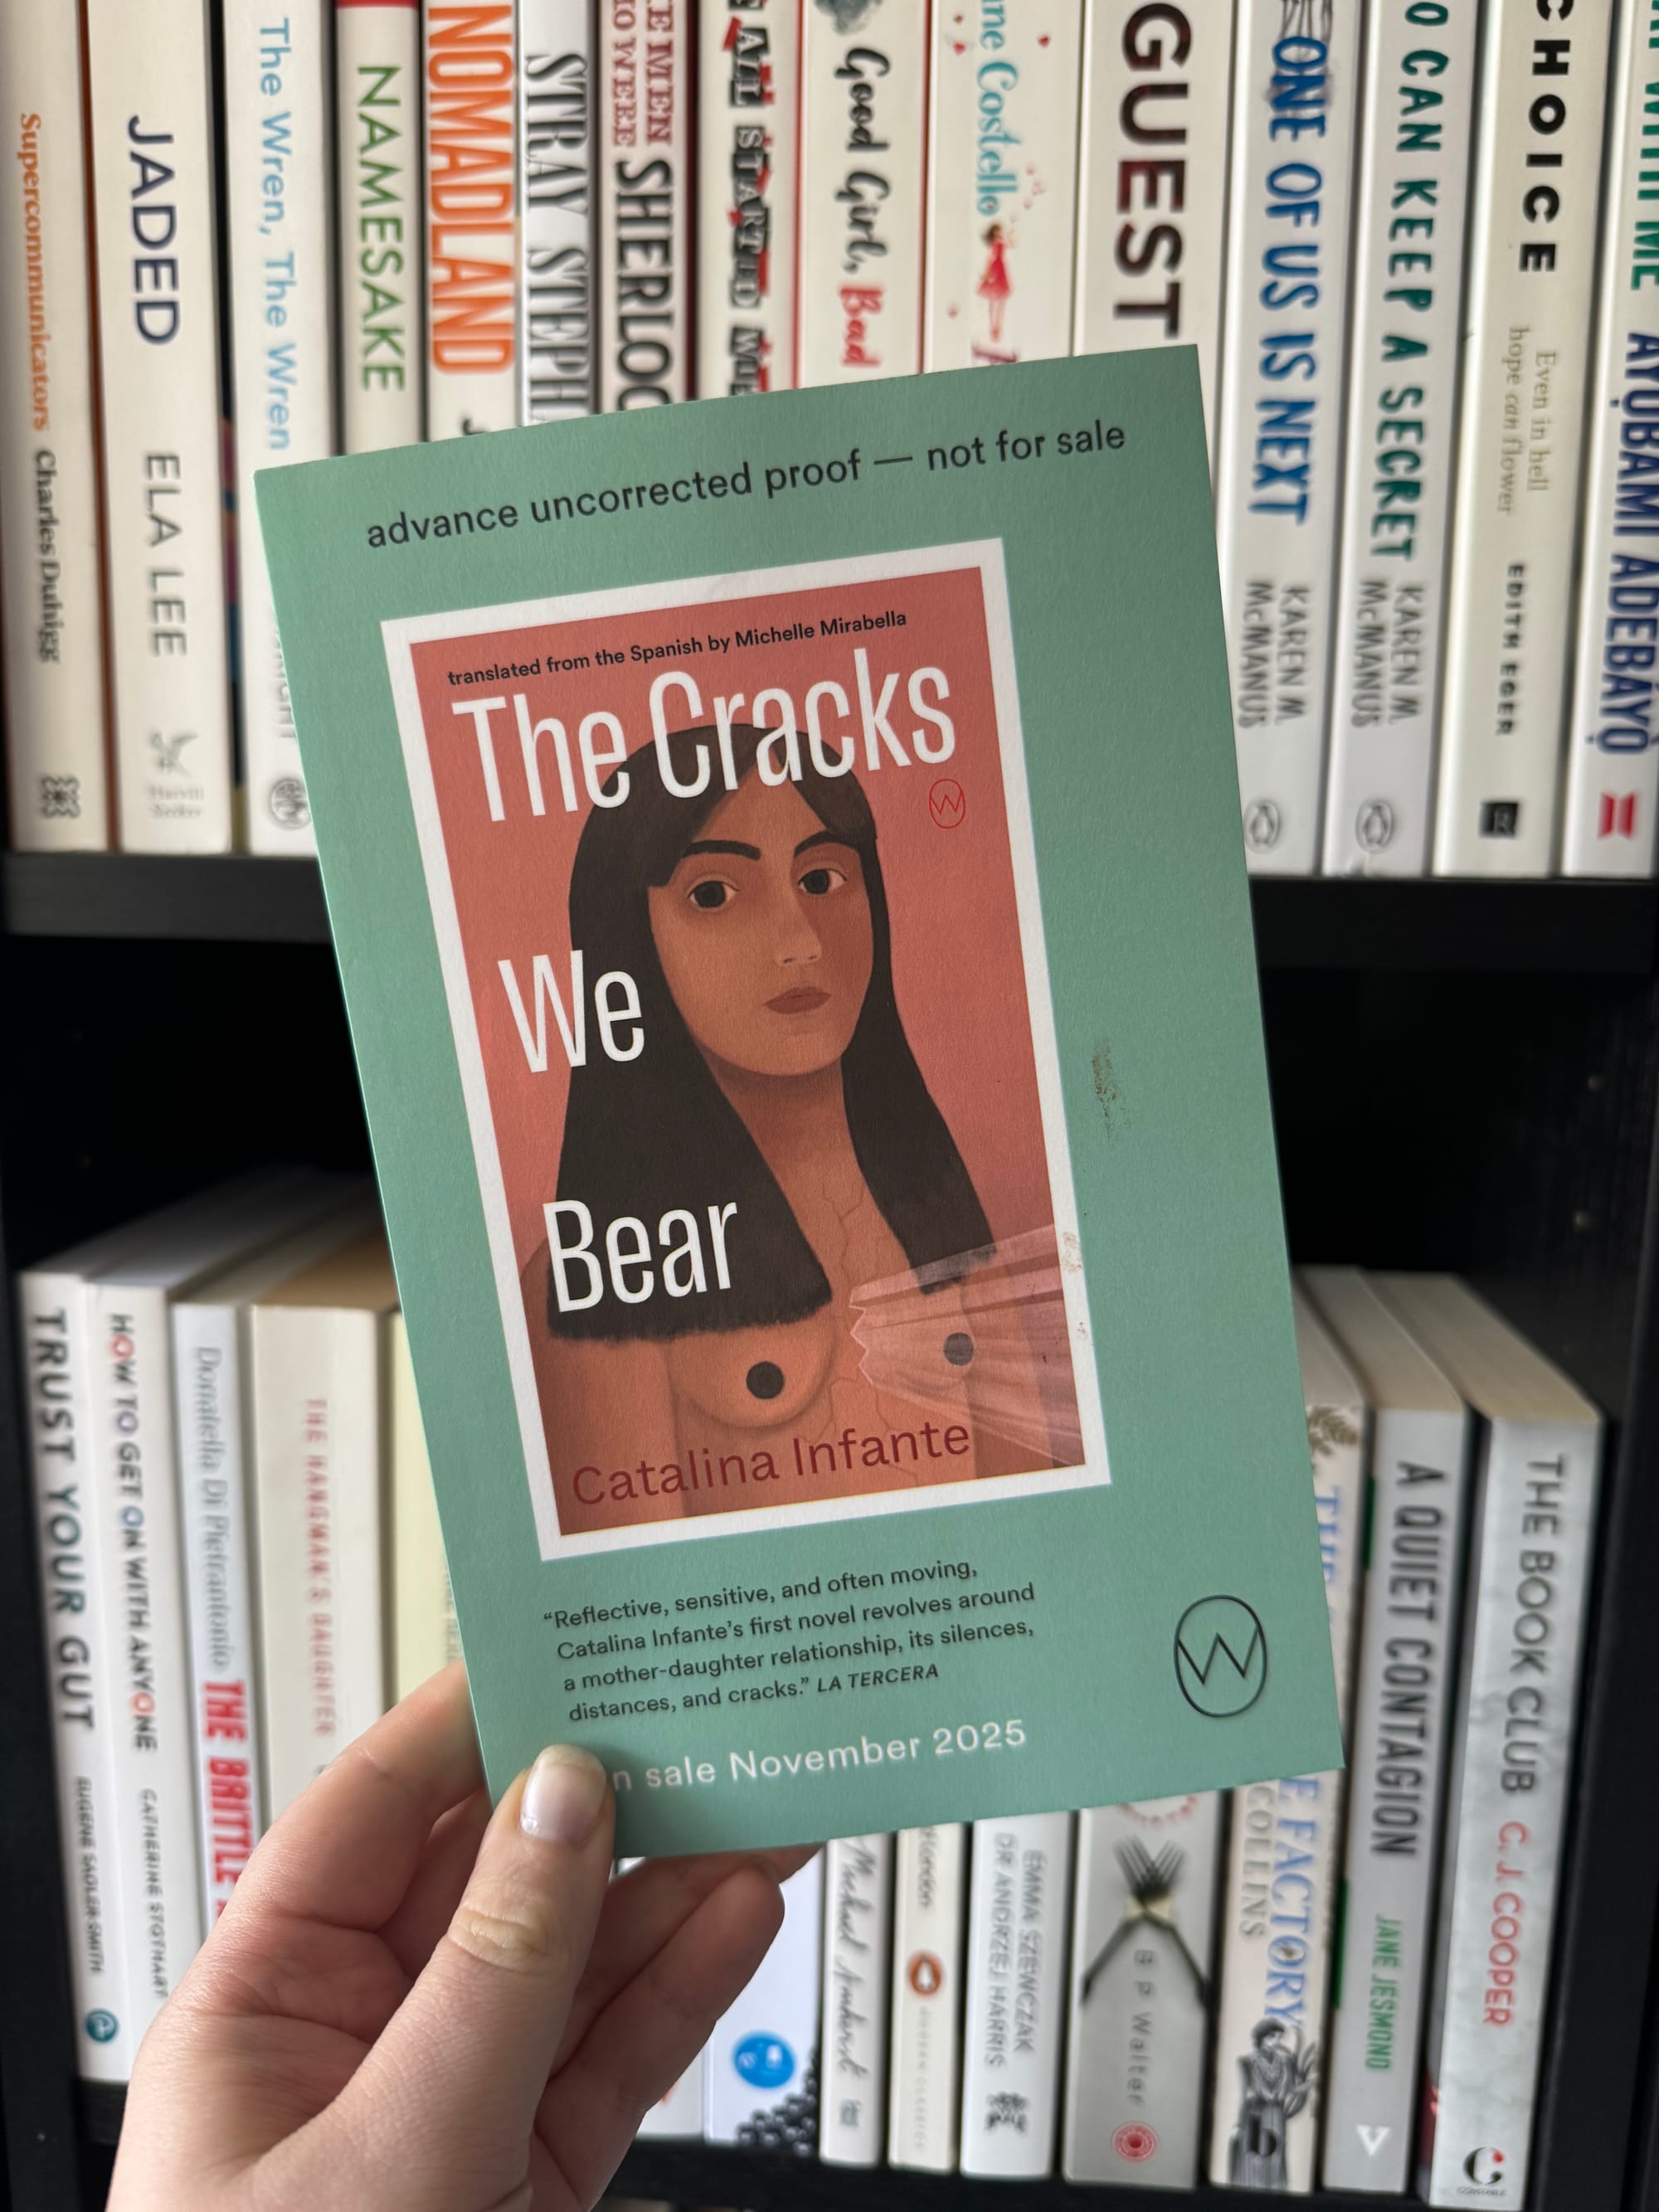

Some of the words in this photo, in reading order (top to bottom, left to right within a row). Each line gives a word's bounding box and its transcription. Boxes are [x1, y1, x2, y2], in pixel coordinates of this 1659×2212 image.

[259, 17, 291, 96] The
[733, 27, 768, 107] ALL
[980, 0, 1005, 50] ne
[525, 53, 588, 216] STRAY
[612, 36, 637, 148] WERE
[647, 41, 674, 146] MEN
[834, 47, 890, 152] Good
[1269, 36, 1327, 141] ONE
[1397, 49, 1449, 153] CAN
[1519, 0, 1574, 272] CHOICE
[259, 111, 292, 236] Wren,
[977, 61, 1020, 216] Costello
[1113, 2, 1192, 339] GUEST
[129, 115, 180, 345] JADED
[358, 66, 404, 391] NAMESAKE
[429, 5, 514, 374] NOMADLAND
[733, 125, 768, 308] STARTED
[835, 171, 890, 274] Girl,
[1266, 163, 1321, 228] OF
[17, 113, 51, 432] Supercommunicators
[265, 252, 297, 328] The
[1259, 245, 1320, 310] US
[1383, 179, 1437, 312] KEEP
[527, 248, 589, 423] STEPH
[839, 284, 883, 367] Bad
[1258, 333, 1316, 382] IS
[1381, 334, 1428, 362] A
[1501, 326, 1530, 386] hope
[266, 343, 298, 450] Wren
[1505, 394, 1521, 434] can
[1531, 415, 1551, 439] in
[1533, 350, 1556, 408] Even
[34, 449, 58, 557] Charles
[144, 453, 182, 547] ELA
[367, 503, 519, 548] advance
[531, 461, 752, 522] uncorrected
[765, 448, 860, 498] proof
[927, 437, 985, 471] not
[995, 430, 1045, 462] for
[1057, 419, 1126, 455] sale
[1248, 399, 1316, 525] NEXT
[1370, 387, 1423, 562] SECRET
[1497, 440, 1522, 516] flower
[1527, 449, 1551, 492] hell
[38, 562, 64, 665] Duhigg
[149, 569, 187, 656] LEE
[448, 659, 541, 686] translated
[547, 653, 590, 674] from
[596, 648, 625, 666] the
[630, 638, 703, 664] Spanish
[708, 634, 730, 655] by
[735, 624, 815, 648] Michelle
[820, 610, 907, 637] Mirabella
[1238, 581, 1272, 727] McMANUS
[1278, 585, 1310, 687] KAREN
[1352, 581, 1386, 727] McMANUS
[1389, 587, 1423, 686] KAREN
[1503, 564, 1524, 648] EDITH
[452, 693, 630, 822] The
[649, 648, 956, 799] Cracks
[1495, 663, 1518, 736] EGER
[498, 950, 645, 1073] We
[542, 1198, 737, 1313] Bear
[33, 1309, 75, 1461] TRUST
[108, 1313, 137, 1392] HOW
[116, 1397, 139, 1435] TO
[193, 1347, 226, 1473] Donatella
[306, 1398, 328, 1443] THE
[118, 1442, 143, 1500] GET
[199, 1479, 228, 1510] Di
[572, 1449, 778, 1505] Catalina
[792, 1420, 971, 1476] Infante
[1397, 1461, 1445, 1486] A
[1523, 1453, 1568, 1534] THE
[47, 1487, 85, 1615] YOUR
[119, 1506, 145, 1553] ON
[1387, 1505, 1444, 1623] QUIET
[124, 1558, 150, 1629] WITH
[202, 1514, 233, 1673] Pietrantonio
[543, 1599, 669, 1629] “Reflective,
[675, 1587, 775, 1612] sensitive,
[781, 1577, 821, 1598] and
[827, 1571, 885, 1594] often
[891, 1560, 978, 1586] moving,
[557, 1633, 646, 1660] Catalina
[652, 1621, 744, 1648] Infante’s
[749, 1614, 793, 1636] first
[799, 1605, 856, 1629] novel
[862, 1597, 952, 1622] revolves
[958, 1582, 1035, 1610] around
[1510, 1550, 1554, 1675] BOOK
[56, 1638, 95, 1729] GUT
[127, 1635, 158, 1752] ANYONE
[311, 1613, 336, 1735] DAUGHTER
[563, 1676, 576, 1692] a
[582, 1651, 765, 1691] mother-daughter
[770, 1635, 903, 1667] relationship,
[908, 1628, 934, 1650] its
[940, 1620, 1034, 1646] silences,
[569, 1694, 677, 1723] distances,
[682, 1687, 722, 1709] and
[728, 1675, 810, 1703] cracks.”
[817, 1676, 842, 1694] LA
[849, 1664, 939, 1690] TERCERA
[204, 1680, 248, 1743] THE
[614, 1769, 632, 1791] n
[645, 1757, 716, 1788] sale
[729, 1735, 920, 1782] November
[933, 1719, 1027, 1757] 2025
[1370, 1637, 1434, 1858] CONTAGION
[1501, 1686, 1543, 1794] CLUB
[76, 1777, 96, 1849] EUGENE
[140, 1789, 160, 1895] CATHERINE
[208, 1757, 254, 1884] BRITTLE
[995, 1834, 1017, 1860] DR
[1021, 1850, 1048, 1923] EMMA
[1239, 1787, 1273, 1938] COLLINS
[1136, 1948, 1155, 1966] B
[1264, 1817, 1316, 2026] FACTORY
[1373, 1914, 1402, 1969] JANE
[1484, 1892, 1525, 2027] COOPER
[985, 1984, 1009, 2069] HARRIS
[1134, 1980, 1155, 1997] P
[1366, 1973, 1398, 2071] JESMOND
[1126, 2012, 1153, 2105] Walter
